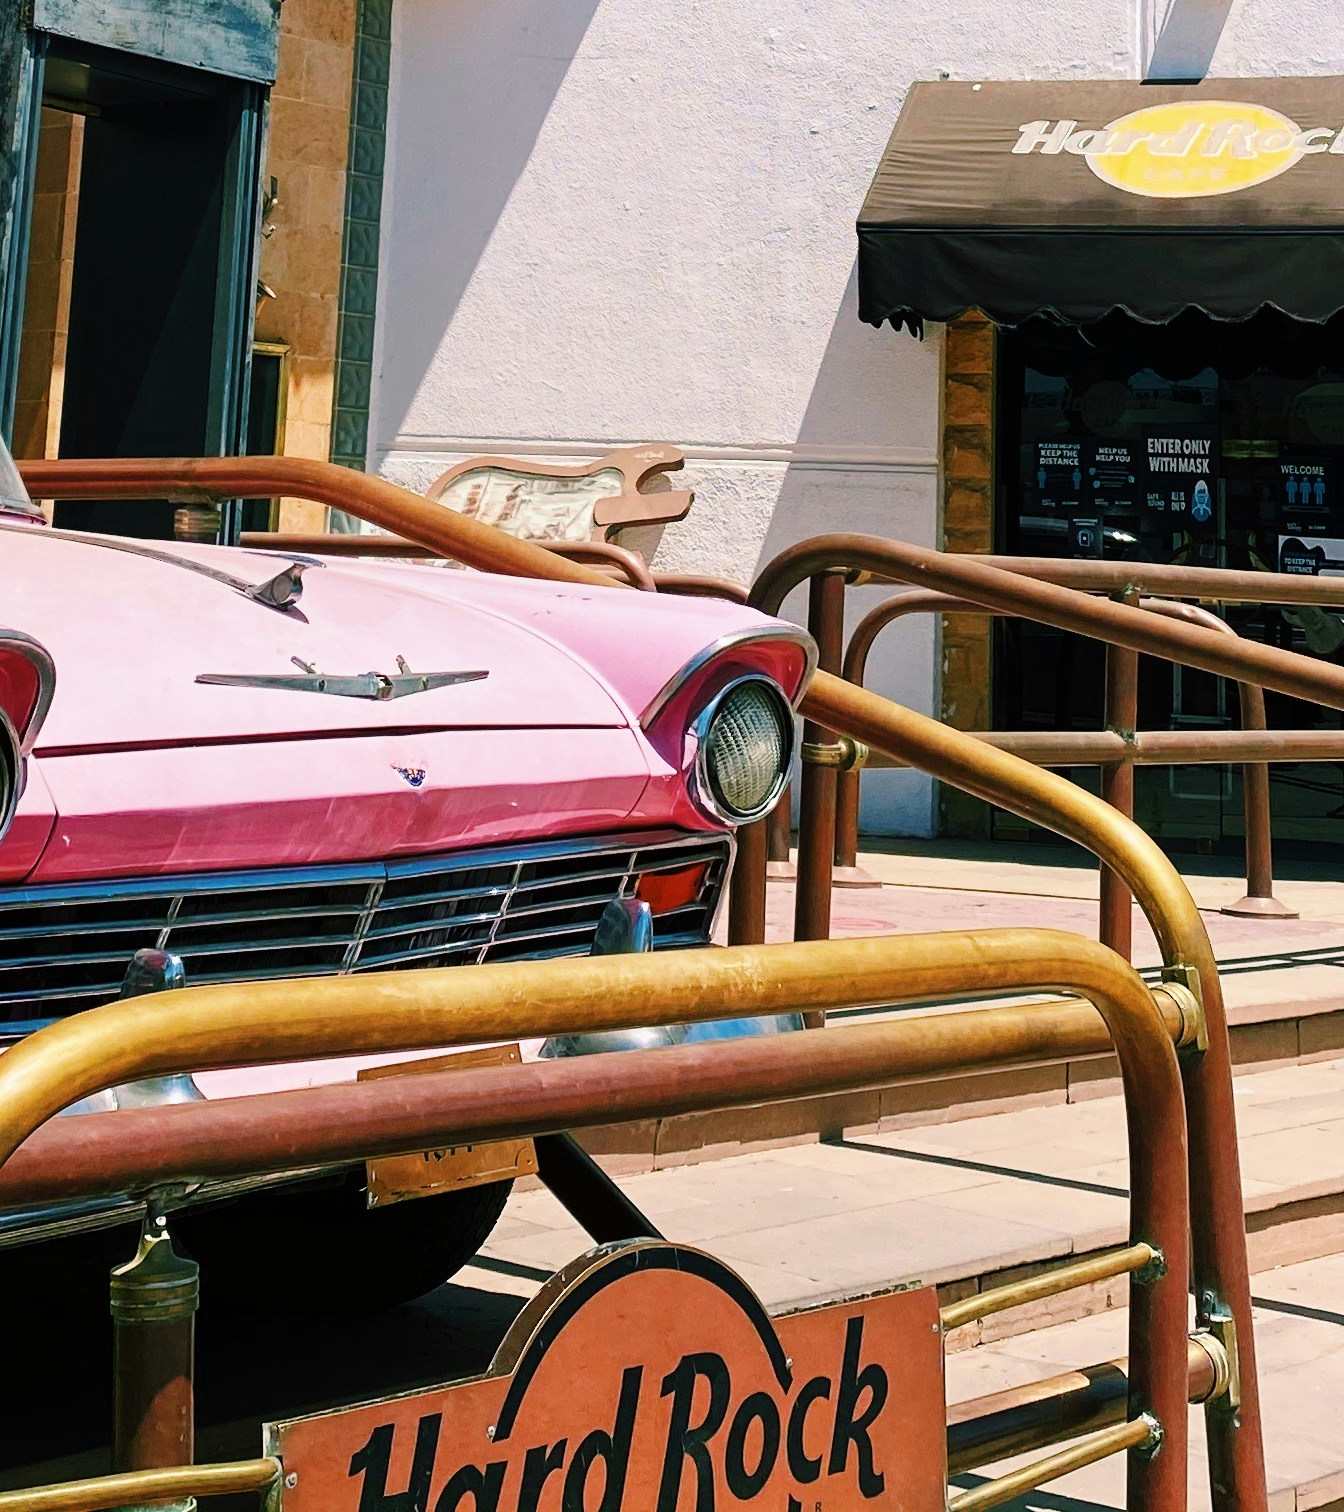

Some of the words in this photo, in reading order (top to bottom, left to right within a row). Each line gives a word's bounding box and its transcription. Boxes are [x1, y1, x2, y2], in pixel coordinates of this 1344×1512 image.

[1011, 118, 1206, 158] Hard
[1147, 438, 1181, 454] ENTER
[1183, 439, 1212, 455] ONLY
[1039, 457, 1079, 466] DISTANCE
[1095, 454, 1113, 462] HELP
[1114, 455, 1131, 463] YOU
[1148, 456, 1177, 473] WITH
[1178, 458, 1210, 474] MASK
[1280, 464, 1325, 476] WELCOME
[659, 1316, 887, 1512] Rock
